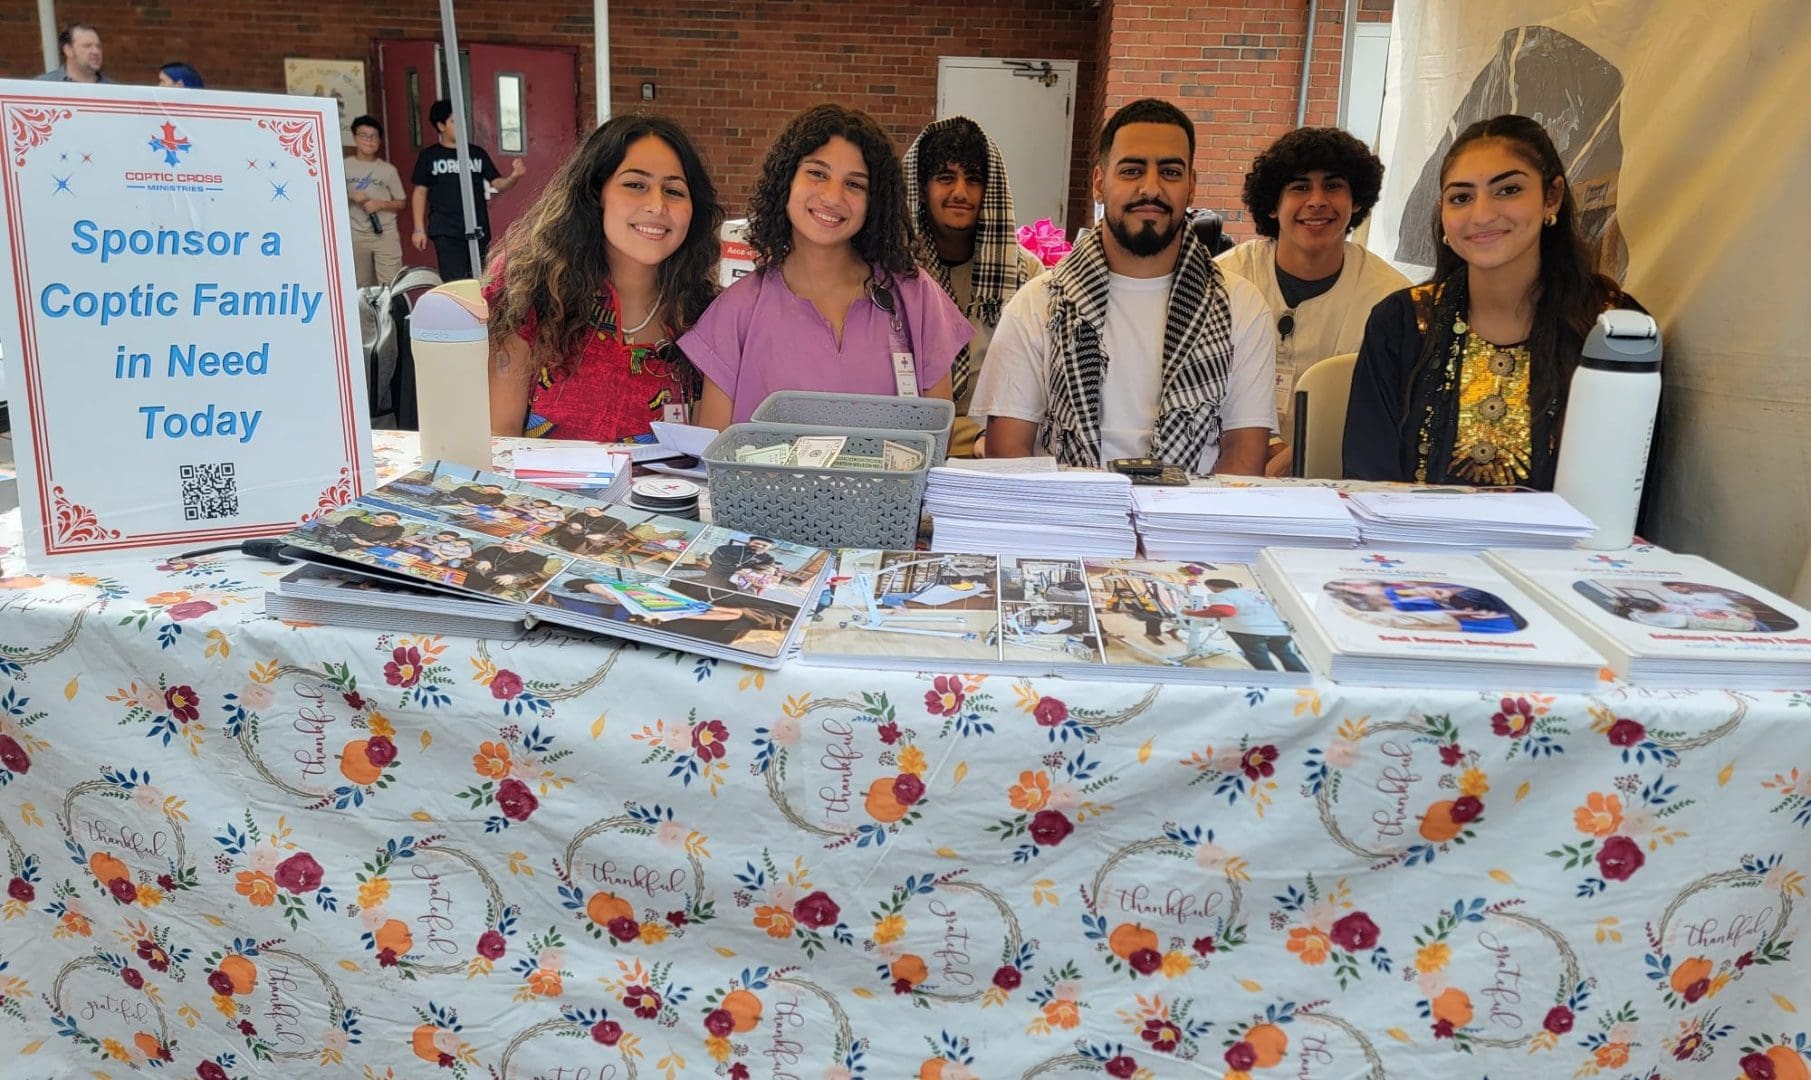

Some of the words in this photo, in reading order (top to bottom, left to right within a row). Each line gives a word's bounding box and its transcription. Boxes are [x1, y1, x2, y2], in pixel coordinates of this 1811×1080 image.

[125, 171, 174, 182] COPTIC
[177, 173, 223, 184] CROSS
[431, 157, 483, 176] JORAN
[147, 184, 204, 192] MINISTRIES
[71, 220, 250, 263] Sponsor
[260, 231, 282, 257] a
[41, 283, 178, 326] Coptic
[193, 283, 323, 324] Family
[116, 346, 153, 379] in
[168, 343, 270, 377] Need
[139, 404, 263, 444] Today
[294, 681, 336, 780] thankful
[824, 718, 864, 818] thankful
[1372, 740, 1420, 842] thankful
[83, 819, 168, 859] thankful
[586, 859, 688, 896] thankful
[410, 863, 458, 956] grateful
[1119, 887, 1224, 923] thankful
[928, 900, 974, 987] grateful
[1684, 906, 1773, 948] thankful
[1478, 930, 1523, 1031] grateful
[80, 995, 149, 1025] grateful
[264, 965, 305, 1046] thankful
